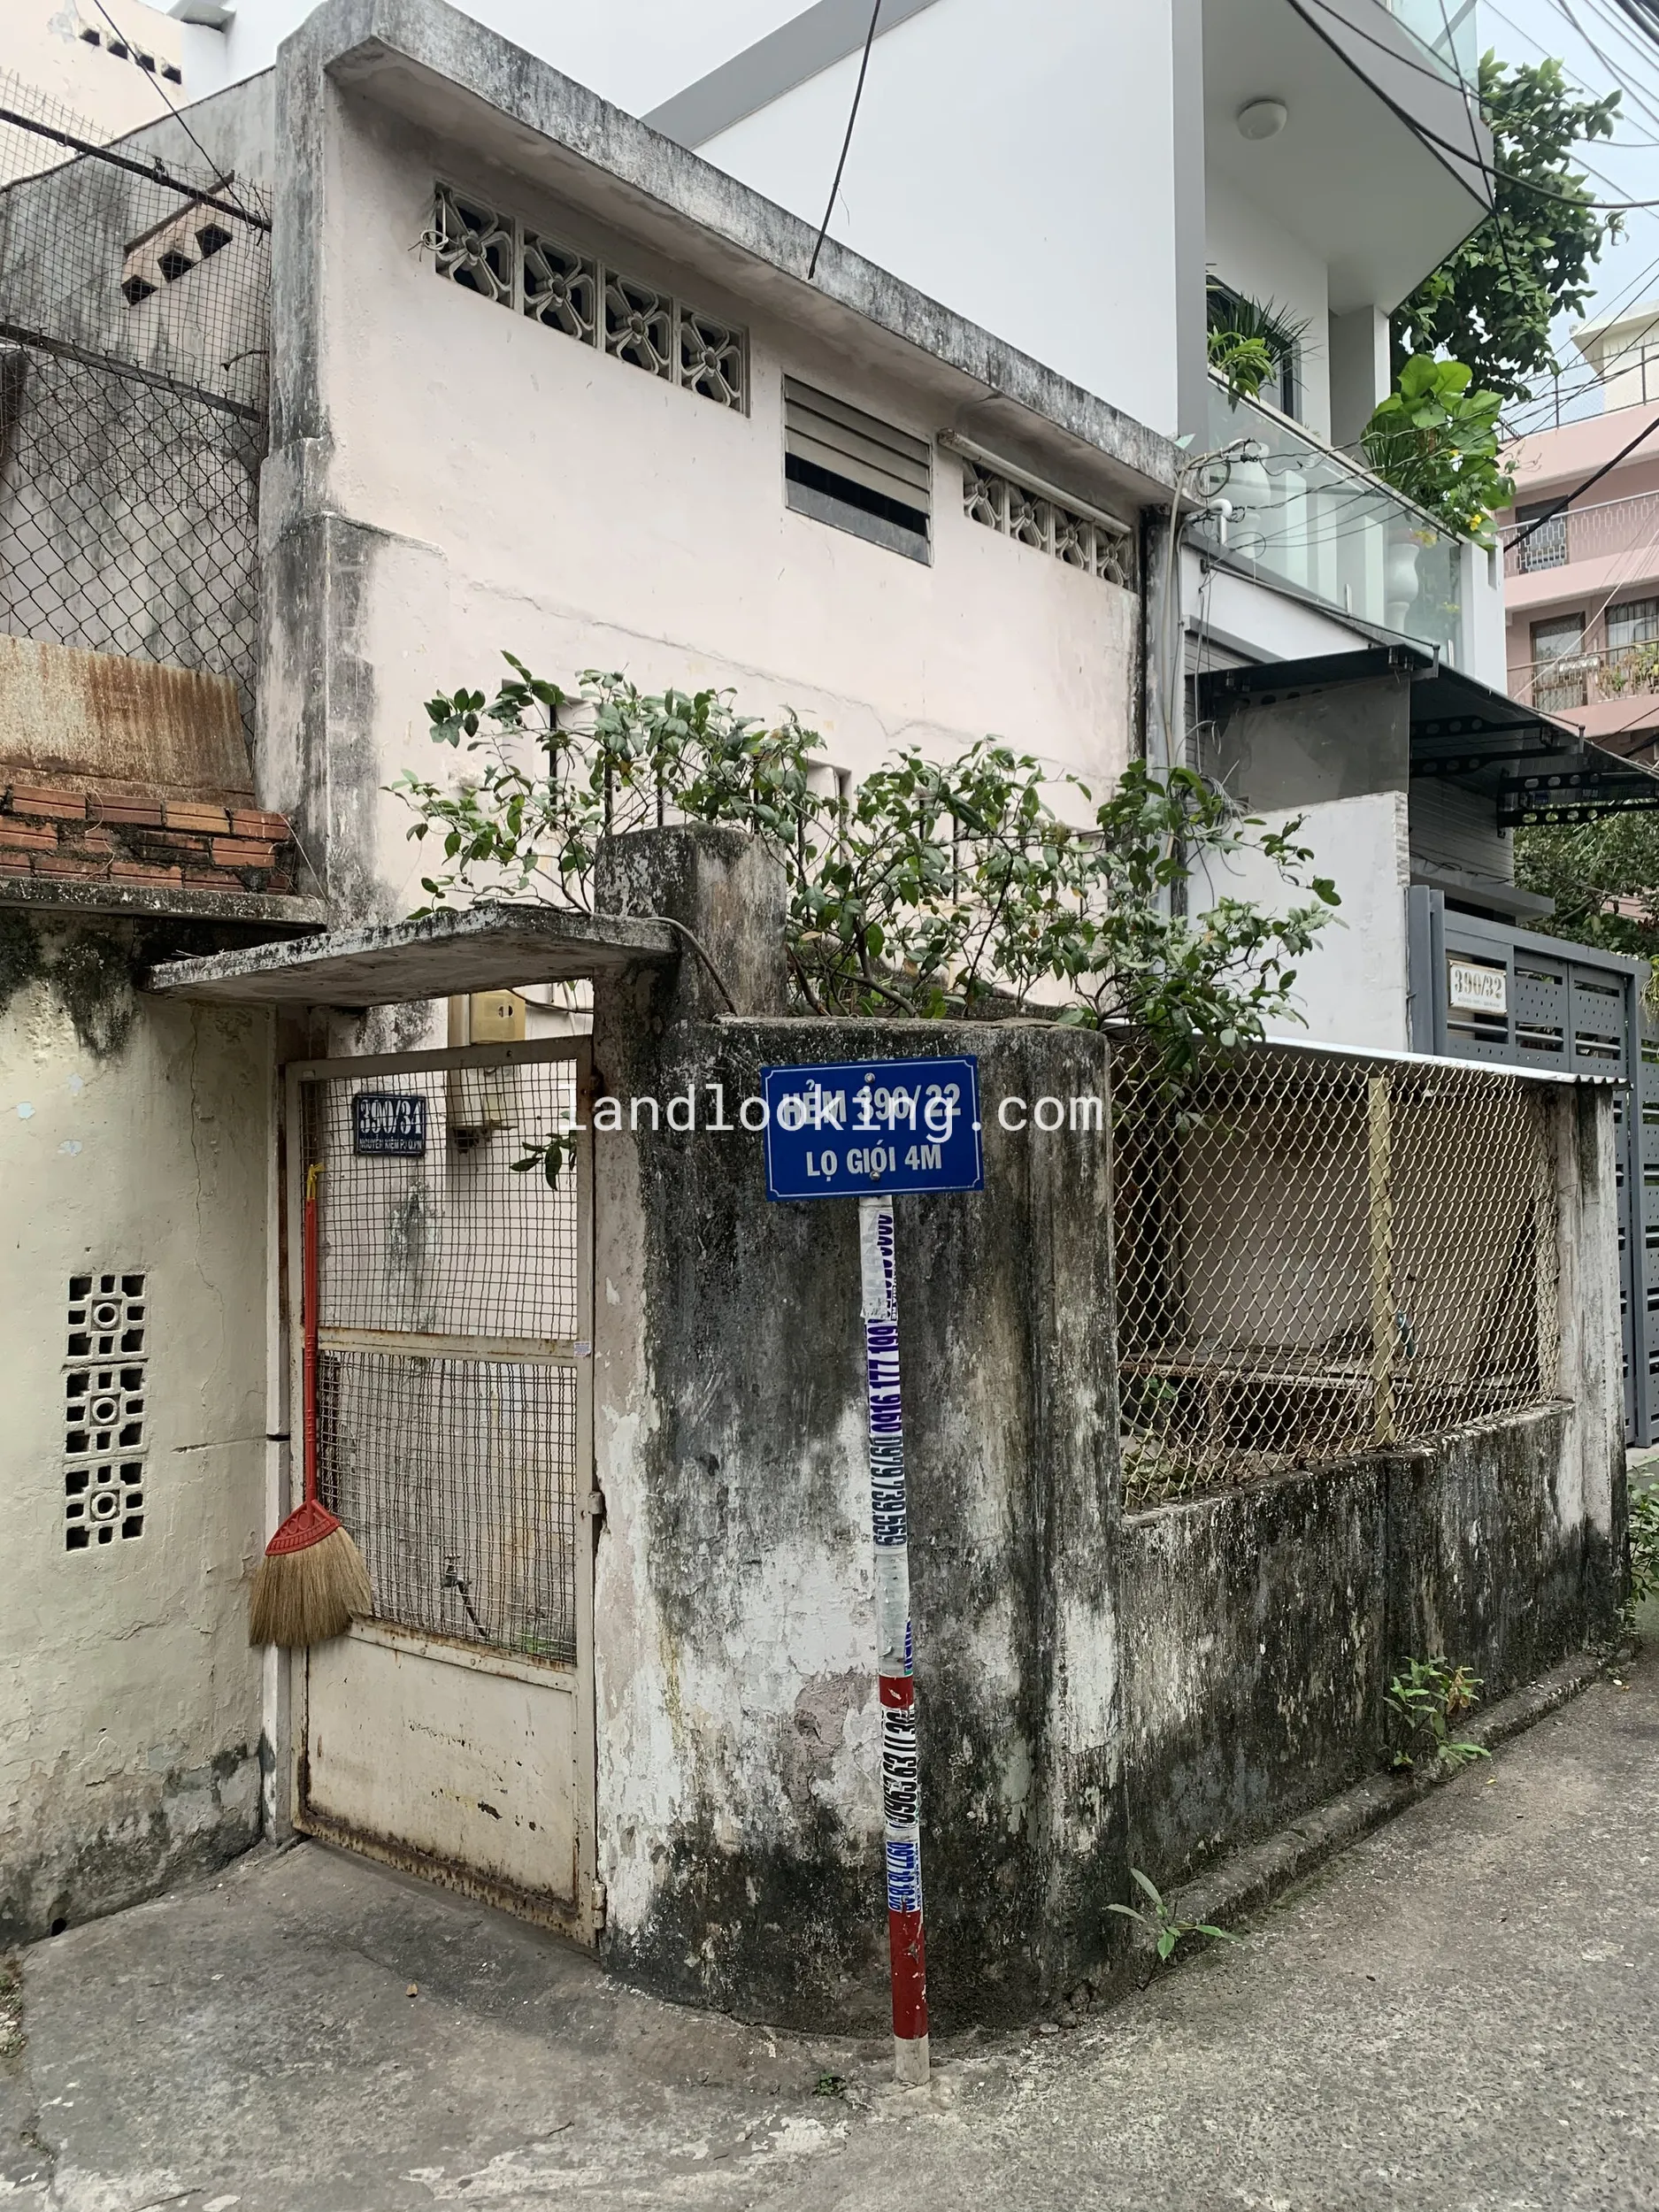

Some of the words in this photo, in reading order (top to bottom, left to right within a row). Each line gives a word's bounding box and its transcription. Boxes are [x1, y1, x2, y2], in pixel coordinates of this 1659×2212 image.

[1455, 970, 1502, 999] 390/32
[360, 1100, 421, 1133] 390/34
[904, 1144, 942, 1171] 4M
[867, 1325, 899, 1354] 199
[868, 1359, 901, 1389] 177
[870, 1394, 902, 1432] 0916
[870, 1436, 907, 1546] 0979.739.559
